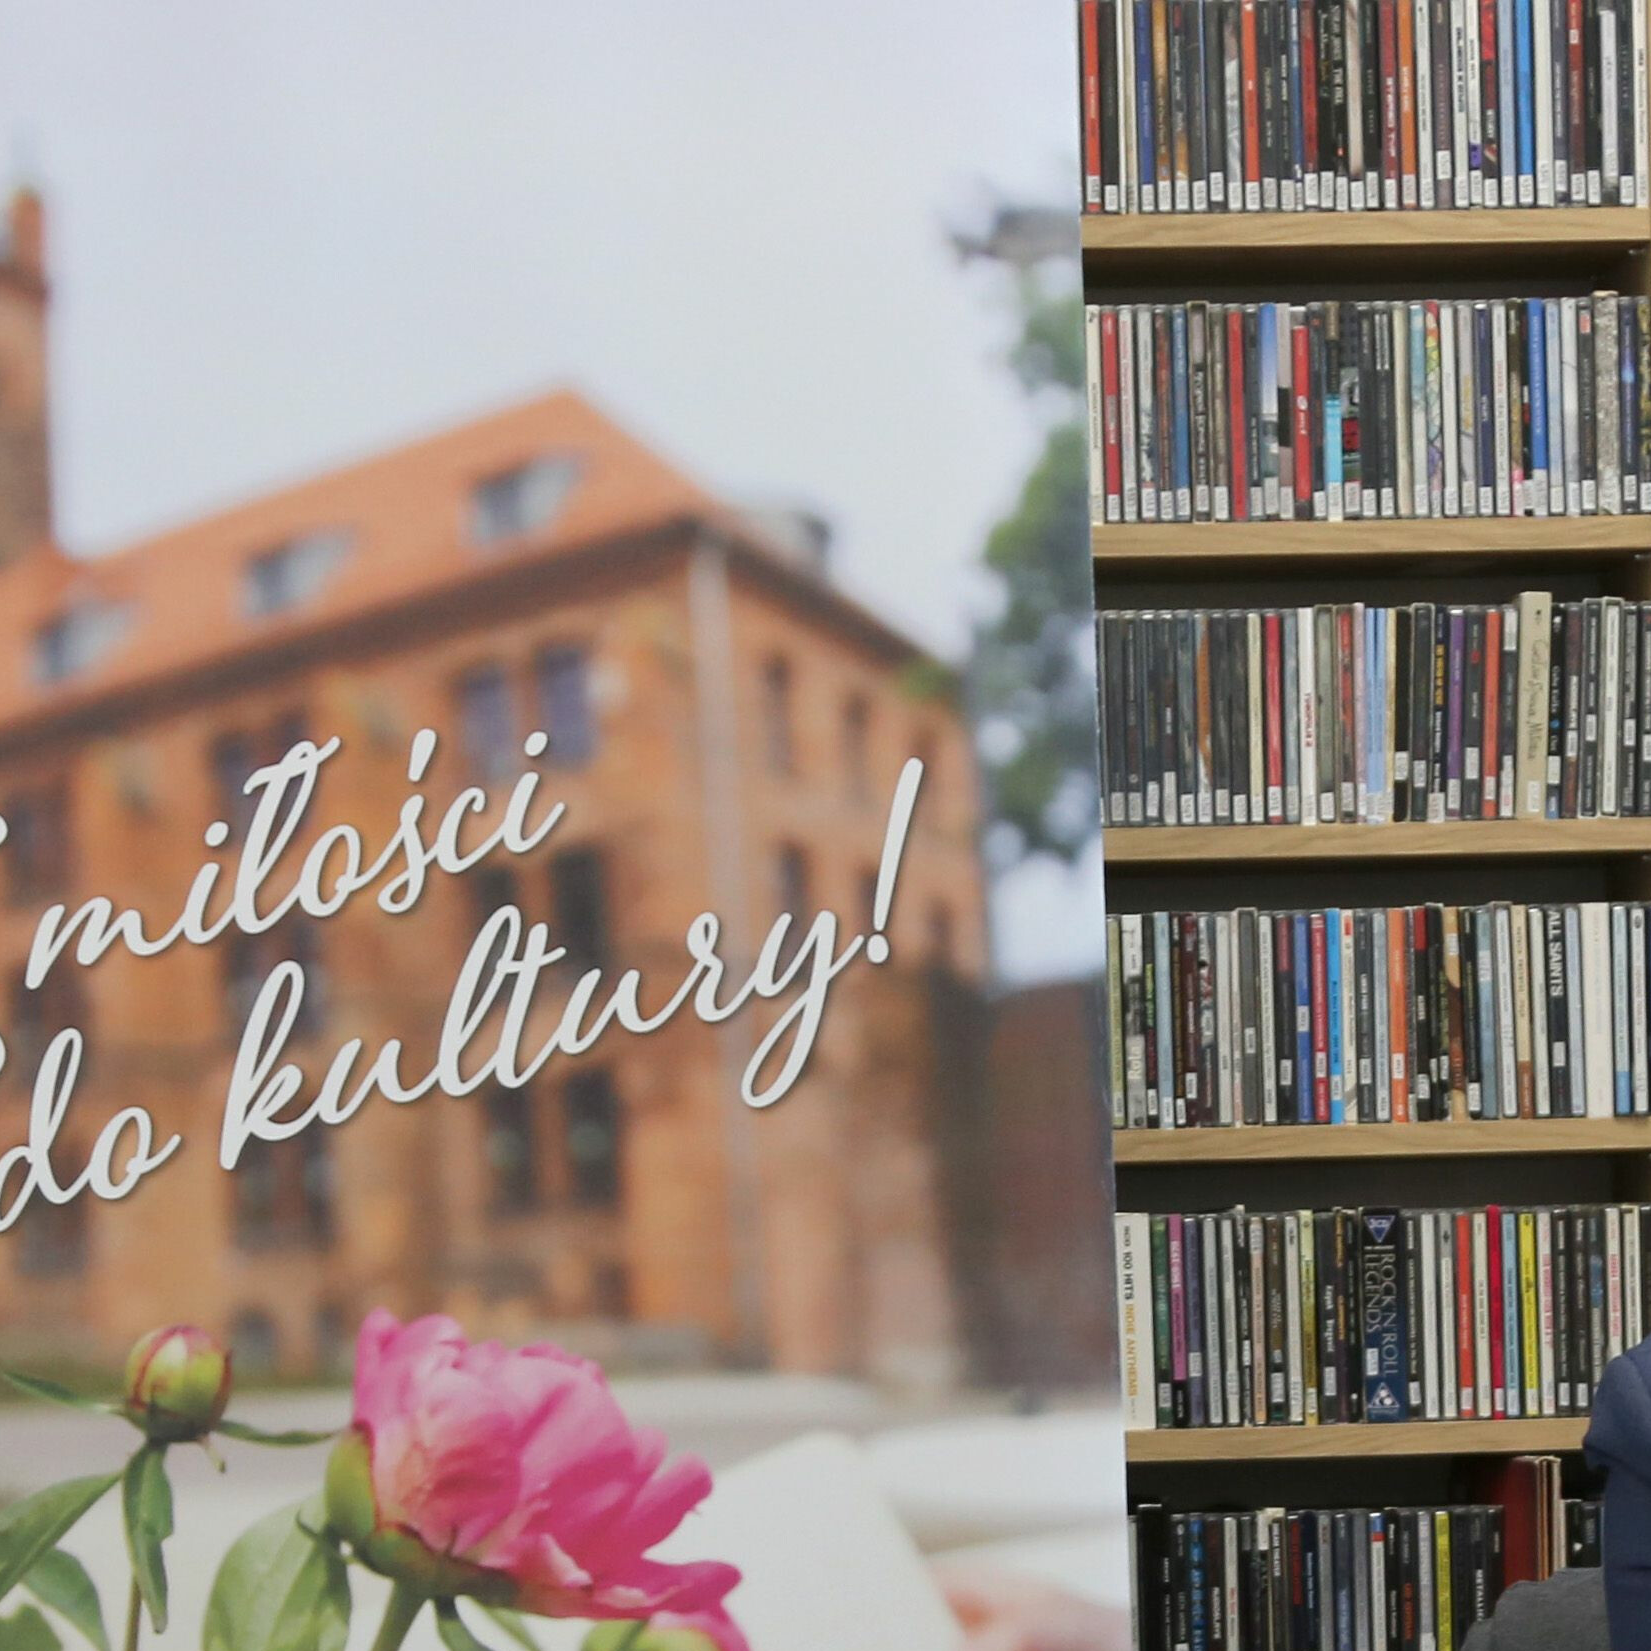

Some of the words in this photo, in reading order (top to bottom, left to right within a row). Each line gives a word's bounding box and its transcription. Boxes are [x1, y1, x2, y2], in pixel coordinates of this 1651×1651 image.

[26, 728, 566, 990] miłości
[1547, 911, 1563, 940] ALL
[220, 757, 925, 1170] kultury!
[1549, 943, 1564, 997] SAINTS
[1124, 1274, 1133, 1300] HITS
[1365, 1253, 1380, 1334] LEGENDS
[1380, 1253, 1399, 1377] ROCK'N'ROLL
[1125, 1304, 1136, 1335] INDIE
[1126, 1338, 1138, 1397] ANTHEMS
[1476, 1569, 1484, 1622] METALLIC
